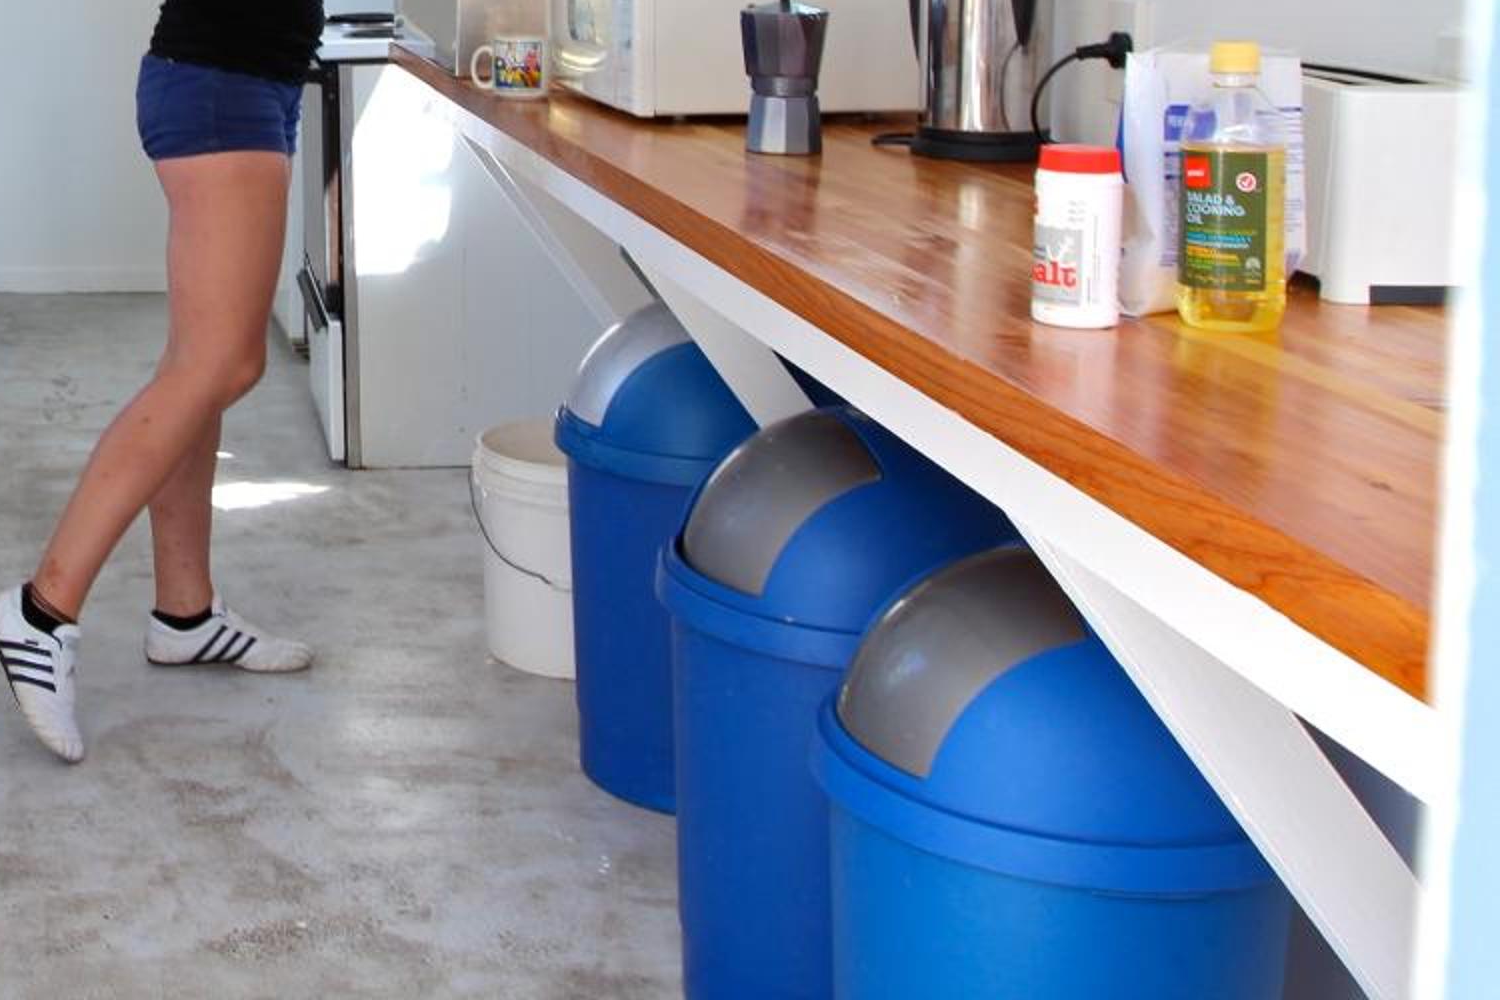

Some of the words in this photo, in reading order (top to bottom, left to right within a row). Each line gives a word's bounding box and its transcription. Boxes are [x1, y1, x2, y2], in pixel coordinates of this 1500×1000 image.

[1187, 191, 1222, 204] SALAD
[1187, 203, 1246, 217] COOKING
[1186, 213, 1204, 225] OIL
[1031, 261, 1077, 288] alt
